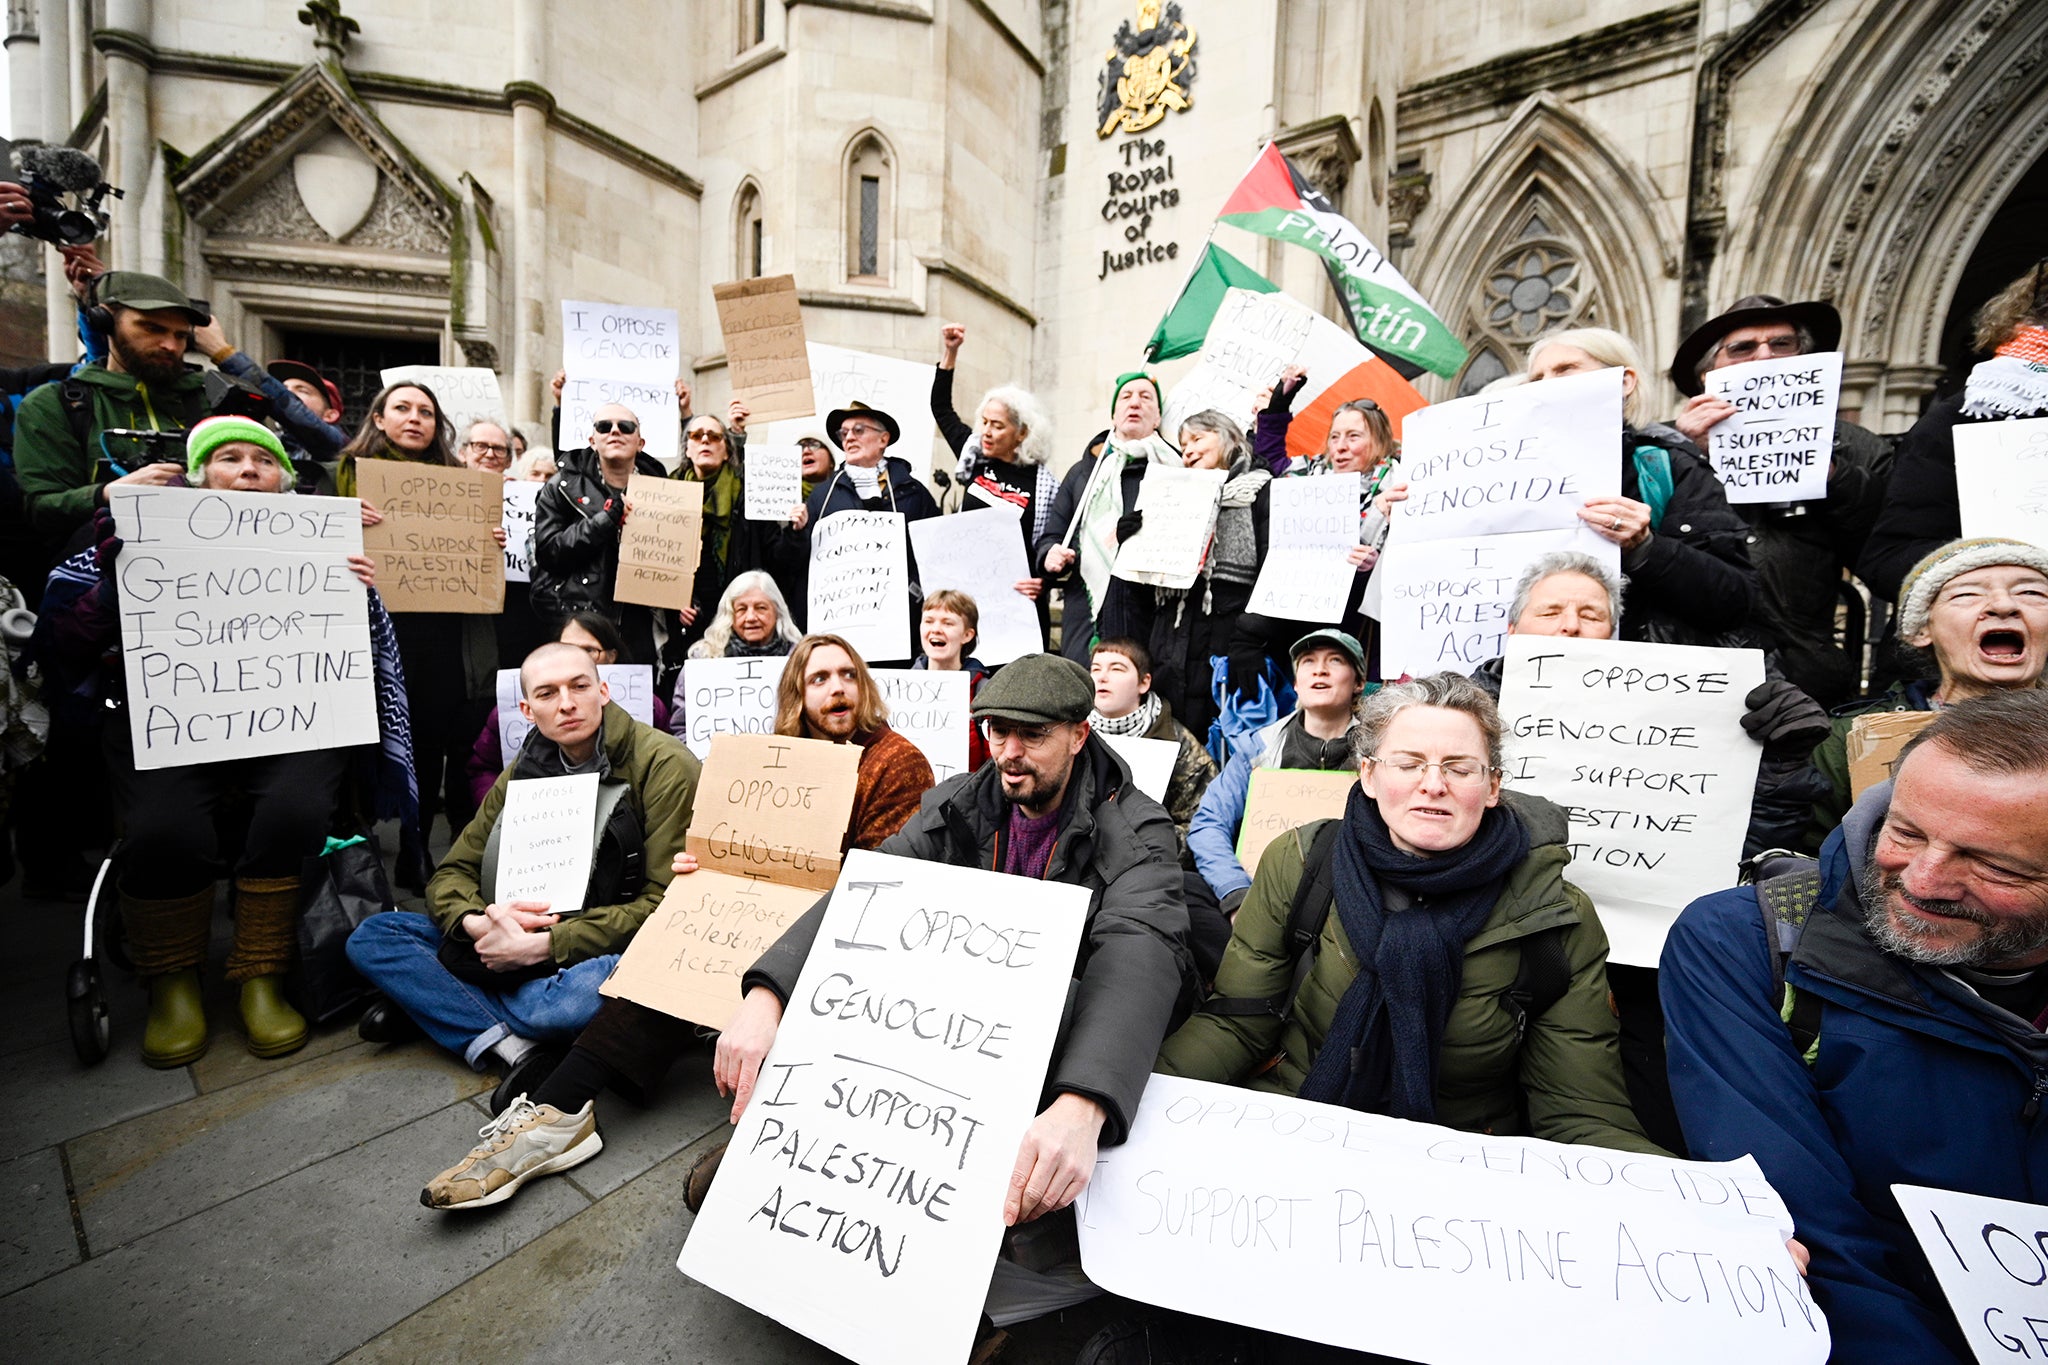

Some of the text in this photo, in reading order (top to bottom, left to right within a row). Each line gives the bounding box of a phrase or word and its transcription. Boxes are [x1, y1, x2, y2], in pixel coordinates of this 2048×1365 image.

[1119, 138, 1165, 166] The
[1107, 155, 1173, 196] Royal
[1101, 188, 1180, 222] Courts
[1124, 214, 1152, 243] of
[1098, 240, 1178, 280] Justice
[570, 311, 667, 336] I OPPOSE
[580, 337, 672, 360] GENOCIDE
[571, 380, 670, 406] I SUPPORT
[1719, 369, 1823, 393] I OPPOSE
[1727, 389, 1824, 413] ENOCIDE
[1473, 400, 1503, 431] I
[1715, 427, 1823, 449] I SUPPORT
[750, 453, 801, 469] I OPPOSE
[1411, 437, 1538, 482] OPPOSE
[1721, 450, 1817, 470] PALESTINE
[381, 475, 484, 499] I OPPOSE
[747, 483, 753, 492] I
[1725, 469, 1800, 487] ACTION
[634, 490, 686, 504] OPPOSE
[1289, 485, 1357, 507] OPPOSE
[1404, 474, 1579, 517] GENOCIDE
[114, 493, 347, 543] I OPPOSE
[383, 498, 501, 524] GENOCIDE
[634, 508, 692, 528] GENOCIDE
[756, 507, 787, 516] ACTION
[406, 533, 495, 553] SUPPORT
[628, 533, 682, 552] SUPPORT
[385, 554, 496, 574] PALESTINE
[1462, 548, 1496, 569] I
[122, 556, 350, 603] GENOCIDE
[398, 575, 479, 596] ACTION
[1395, 577, 1512, 599] SUPPORT
[823, 594, 887, 621] ACTION
[125, 611, 344, 652] I SUPPORT
[141, 650, 369, 698] PALESTINE
[736, 660, 763, 680] I
[1528, 654, 1729, 694] I OPPOSE
[696, 685, 774, 709] OPPO
[147, 702, 317, 749] ACTION
[1513, 715, 1699, 749] GENOCIDE
[763, 745, 791, 769] I
[1513, 756, 1547, 780] I
[532, 786, 574, 801] OPPOSE
[727, 779, 822, 811] OPPOSE
[1257, 783, 1346, 801] I OPPOS
[513, 808, 582, 826] GENOCIDE
[529, 835, 572, 850] SUPPORT
[708, 821, 817, 873] GENOCIDE
[507, 883, 547, 899] ACTION
[736, 871, 770, 897] I
[834, 880, 1041, 968] I OPPOSE
[810, 972, 1012, 1059] GENOCIDE
[761, 1062, 984, 1171] I SUPPORT
[750, 1118, 957, 1222] PALESTINE
[1165, 1096, 1775, 1219] OPPOSE GENOCIDE
[748, 1186, 906, 1278] ACTION
[1930, 1210, 1970, 1272] I
[1136, 1170, 1313, 1251] SUPPORT
[1335, 1189, 1583, 1288] PALESTINE
[1615, 1221, 1817, 1332] ACTION
